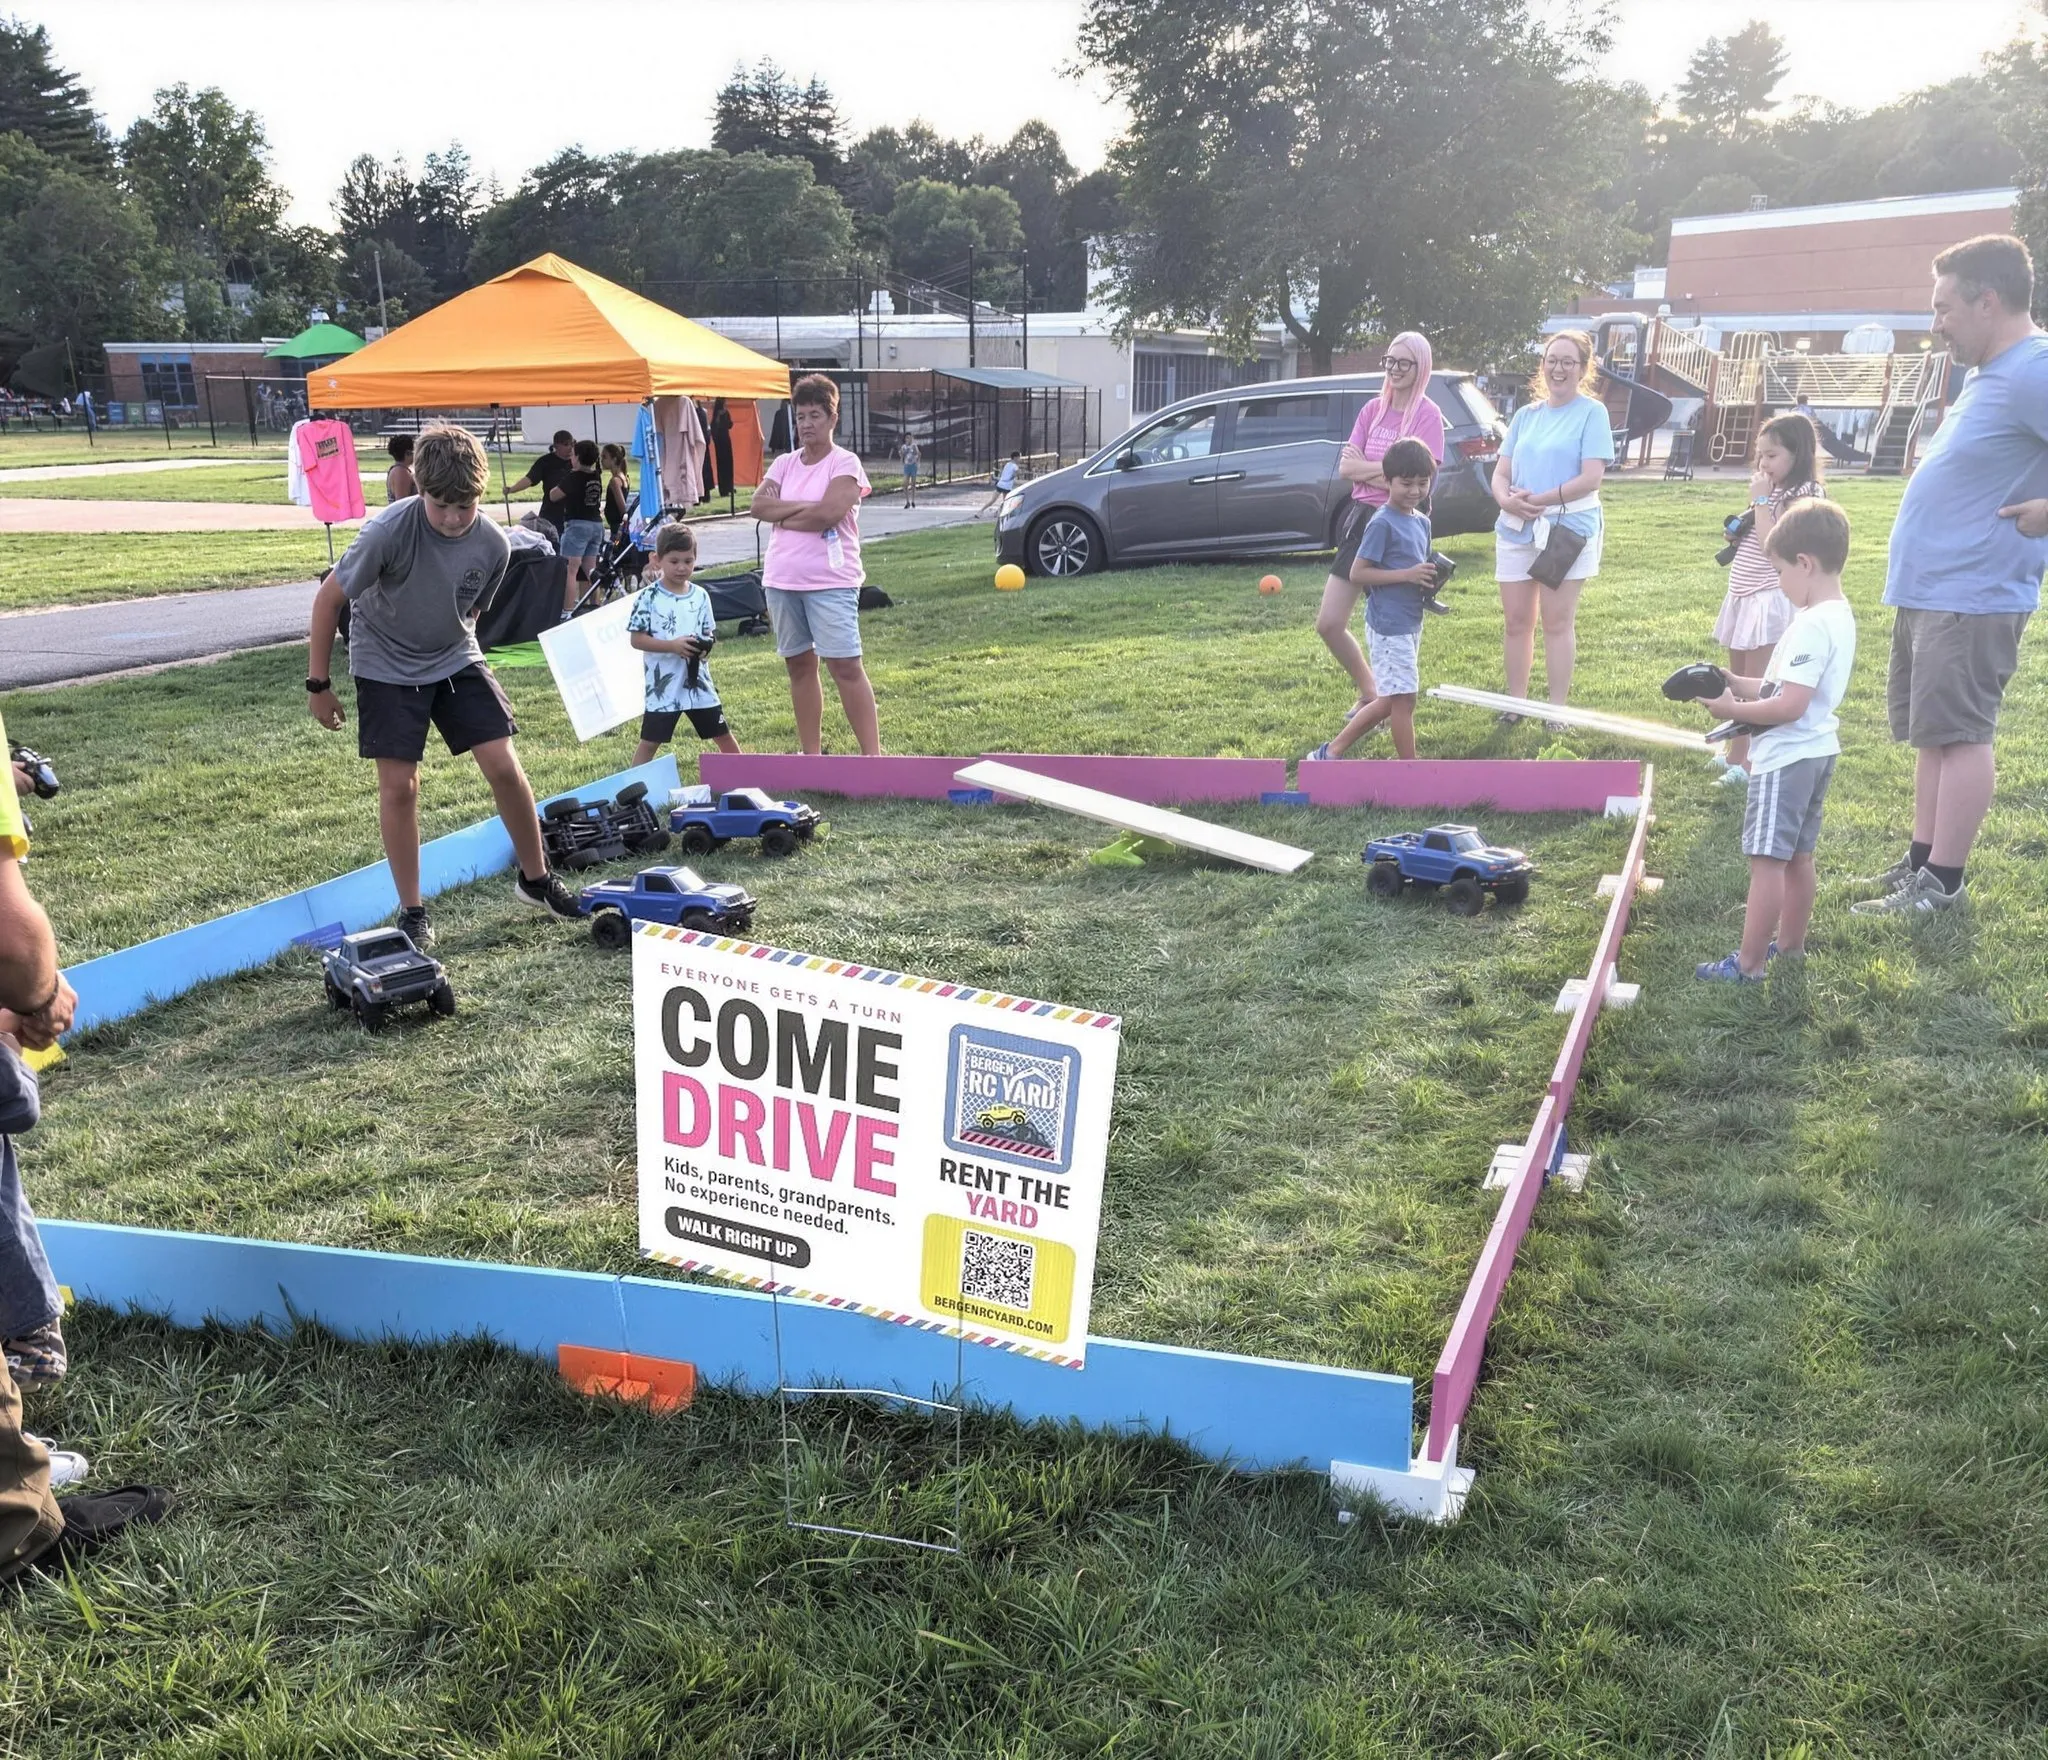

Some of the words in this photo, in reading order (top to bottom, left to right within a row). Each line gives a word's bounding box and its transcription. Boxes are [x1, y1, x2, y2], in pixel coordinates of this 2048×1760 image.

[661, 963, 759, 993] EVERYONE
[770, 987, 818, 1006] GETS
[828, 999, 838, 1010] A
[852, 1003, 901, 1024] TURN
[661, 986, 902, 1113] COME
[970, 1055, 1014, 1076] BERGEN
[968, 1070, 997, 1098] RC
[663, 1070, 899, 1197] DRIVE
[665, 1156, 703, 1181] Kids,
[708, 1170, 774, 1198] parents,
[779, 1187, 895, 1225] grandparents.
[665, 1176, 685, 1195] No
[690, 1185, 779, 1216] experience
[784, 1207, 848, 1234] needed.
[939, 1157, 1011, 1195] RENT
[1018, 1175, 1070, 1209] THE
[966, 1191, 1038, 1228] YARD
[677, 1215, 722, 1240] WALK
[725, 1227, 773, 1252] RIGHT
[775, 1241, 797, 1258] UP
[934, 1295, 1053, 1335] BERGENRCYARD.COM
